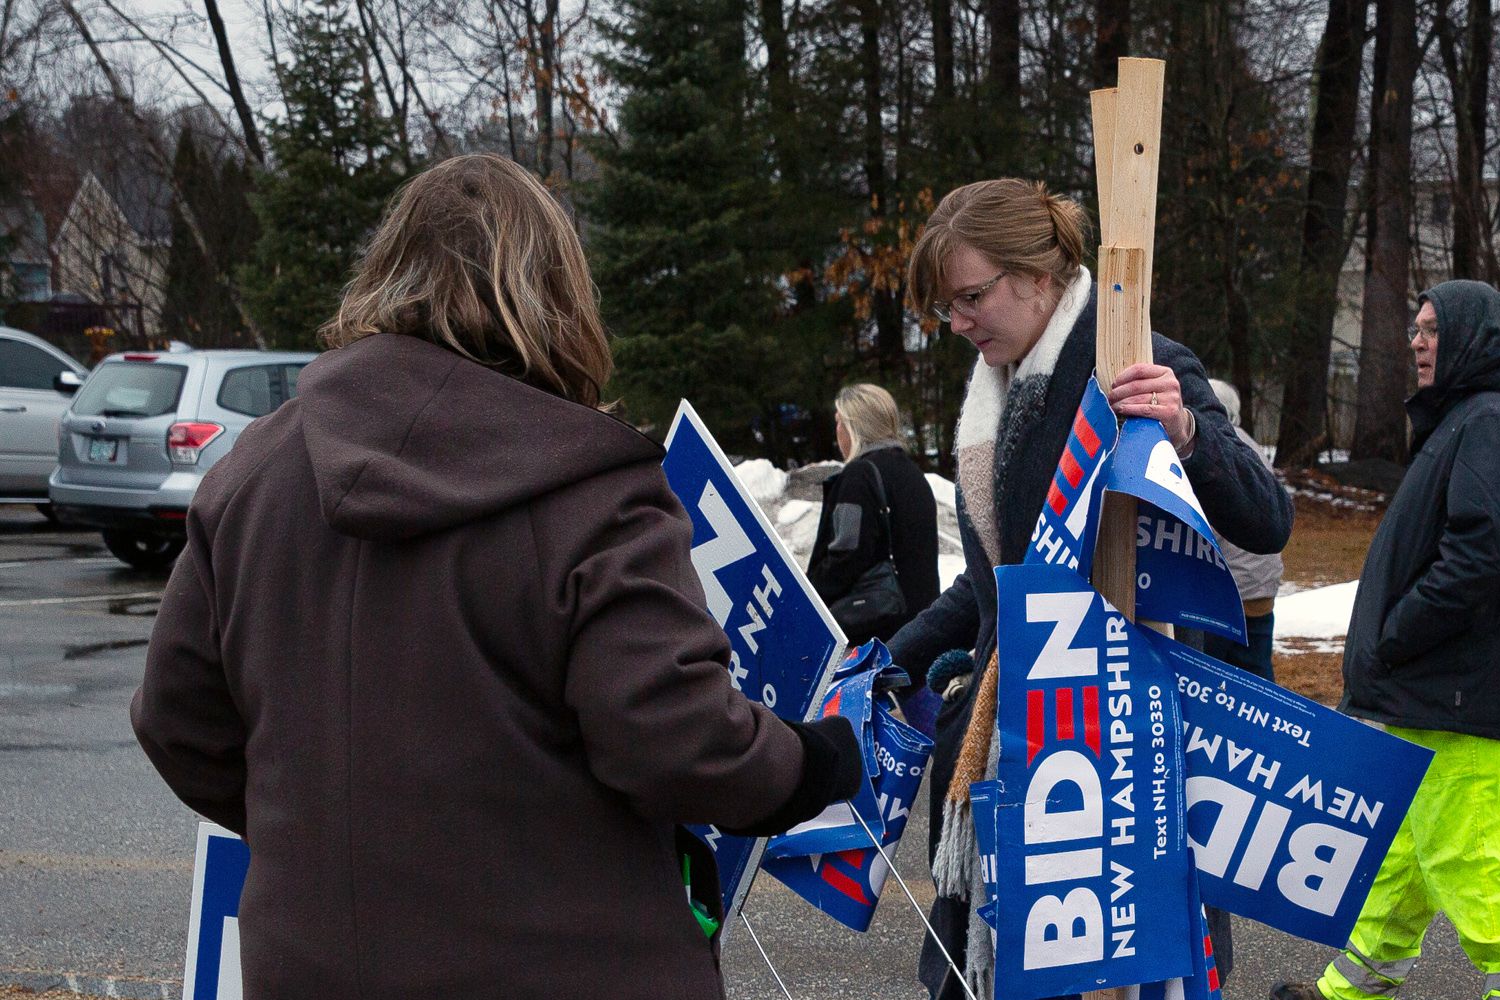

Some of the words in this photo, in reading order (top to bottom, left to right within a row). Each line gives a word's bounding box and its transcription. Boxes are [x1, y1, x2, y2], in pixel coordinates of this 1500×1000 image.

[737, 562, 783, 656] NH
[1148, 685, 1165, 748] 30330
[1215, 692, 1236, 712] to
[1237, 706, 1270, 727] NH
[1273, 716, 1313, 748] Text
[1023, 591, 1104, 971] BIDEN
[1152, 751, 1165, 775] to
[1152, 778, 1166, 812] NH
[1284, 774, 1384, 830] NEW
[1153, 815, 1168, 860] Text
[1112, 864, 1136, 960] NEW
